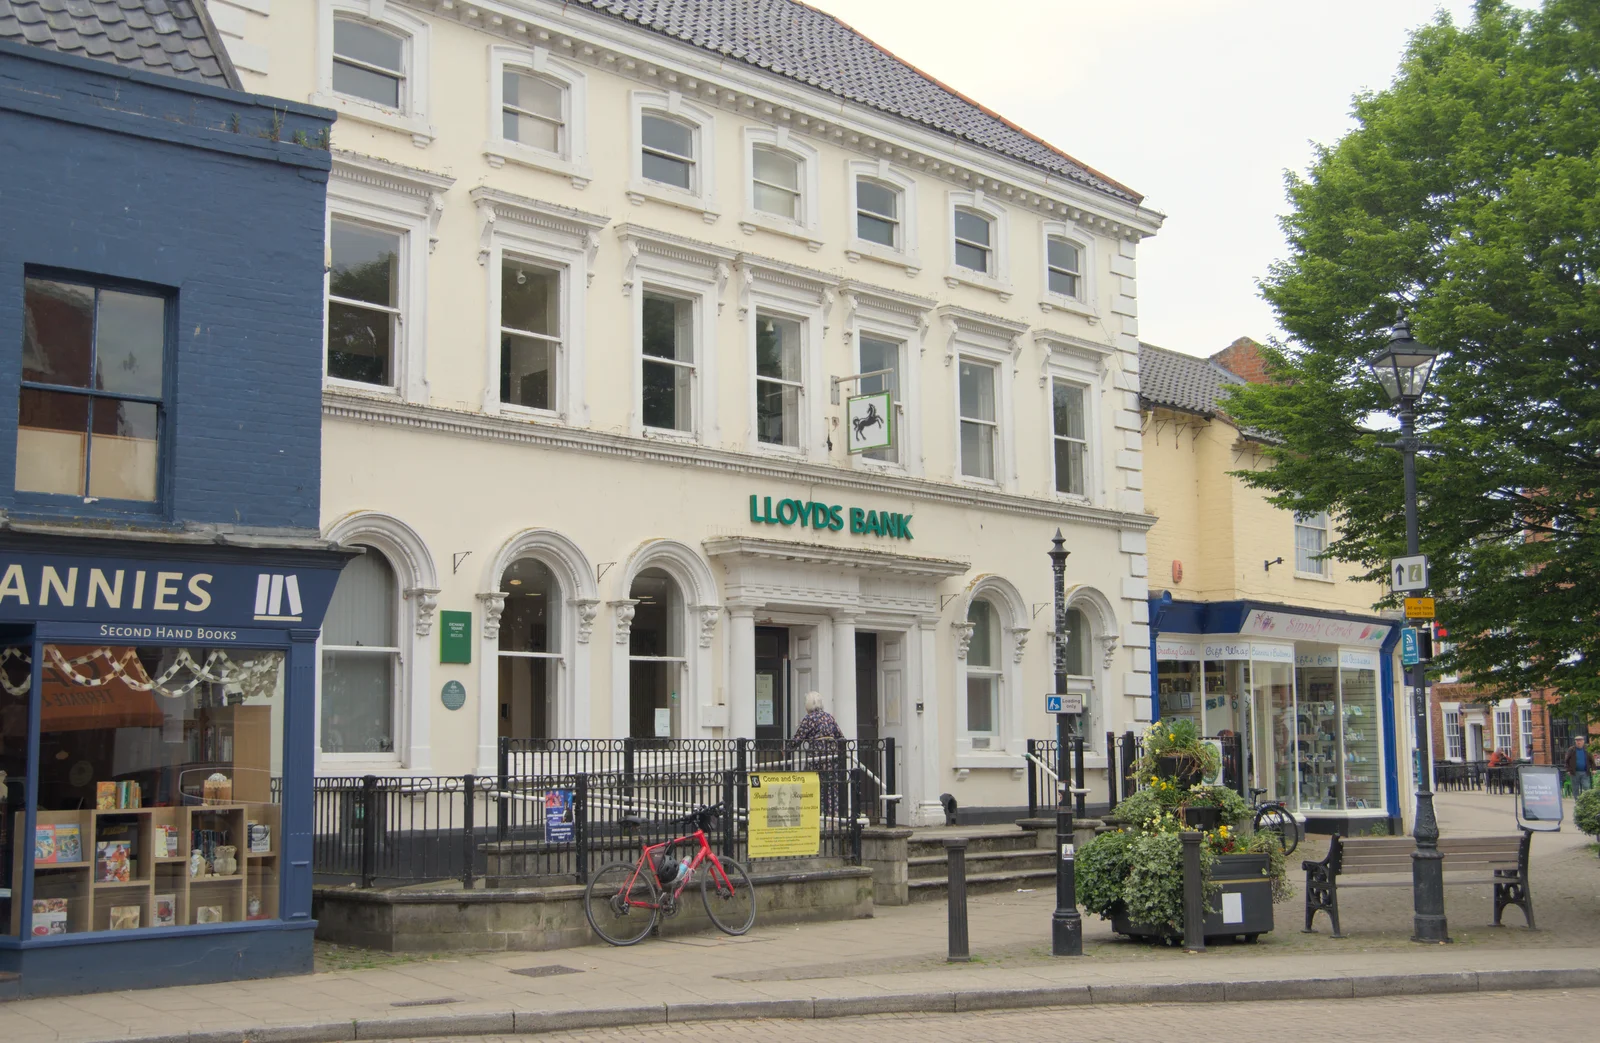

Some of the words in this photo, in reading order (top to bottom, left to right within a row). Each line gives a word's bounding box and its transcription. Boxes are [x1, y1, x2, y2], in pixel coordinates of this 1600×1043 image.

[749, 494, 845, 531] LLOYDS
[849, 507, 914, 540] BANK
[0, 564, 213, 612] ANNIES
[100, 624, 152, 638] SECOND
[156, 626, 193, 639] HAND
[197, 628, 237, 640] BOOKS
[1286, 617, 1324, 637] Simply
[1325, 622, 1355, 638] Cards
[1205, 646, 1222, 658] Gift
[792, 775, 805, 783] Sing
